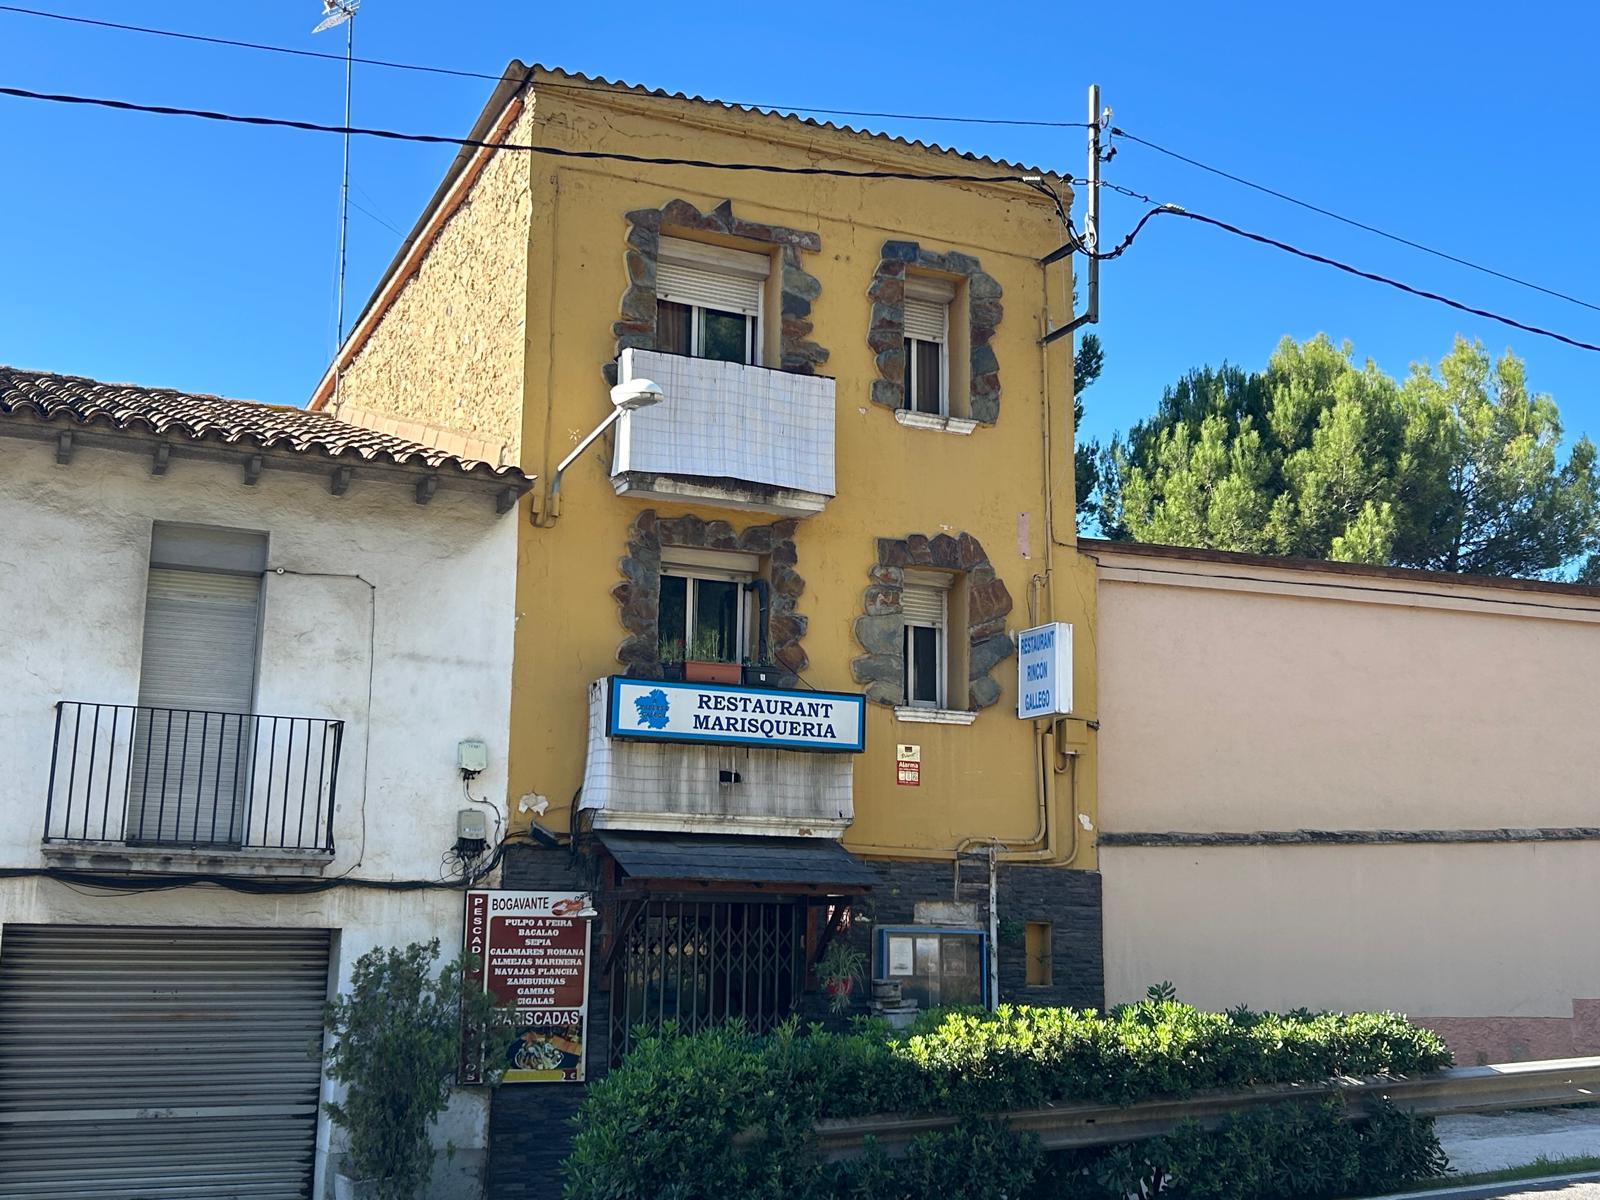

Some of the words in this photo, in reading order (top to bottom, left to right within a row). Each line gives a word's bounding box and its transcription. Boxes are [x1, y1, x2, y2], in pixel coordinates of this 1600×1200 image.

[1021, 631, 1055, 655] RESTAURANT
[1025, 690, 1050, 710] GALLEGO
[698, 694, 833, 718] RESTAURANT
[693, 714, 836, 738] MARISQUERIA
[492, 896, 549, 911] BOGAVANTE
[545, 919, 573, 927] FEIRA
[525, 938, 551, 946] SEPIA
[490, 948, 544, 956] CALAMARES
[547, 948, 584, 956] ROMANA
[491, 958, 533, 966] ALMEJAS
[535, 958, 582, 966] MARINERA
[538, 968, 578, 976] PLANCHA
[517, 987, 555, 995] GAMBAS
[517, 997, 555, 1005] CIGALAS
